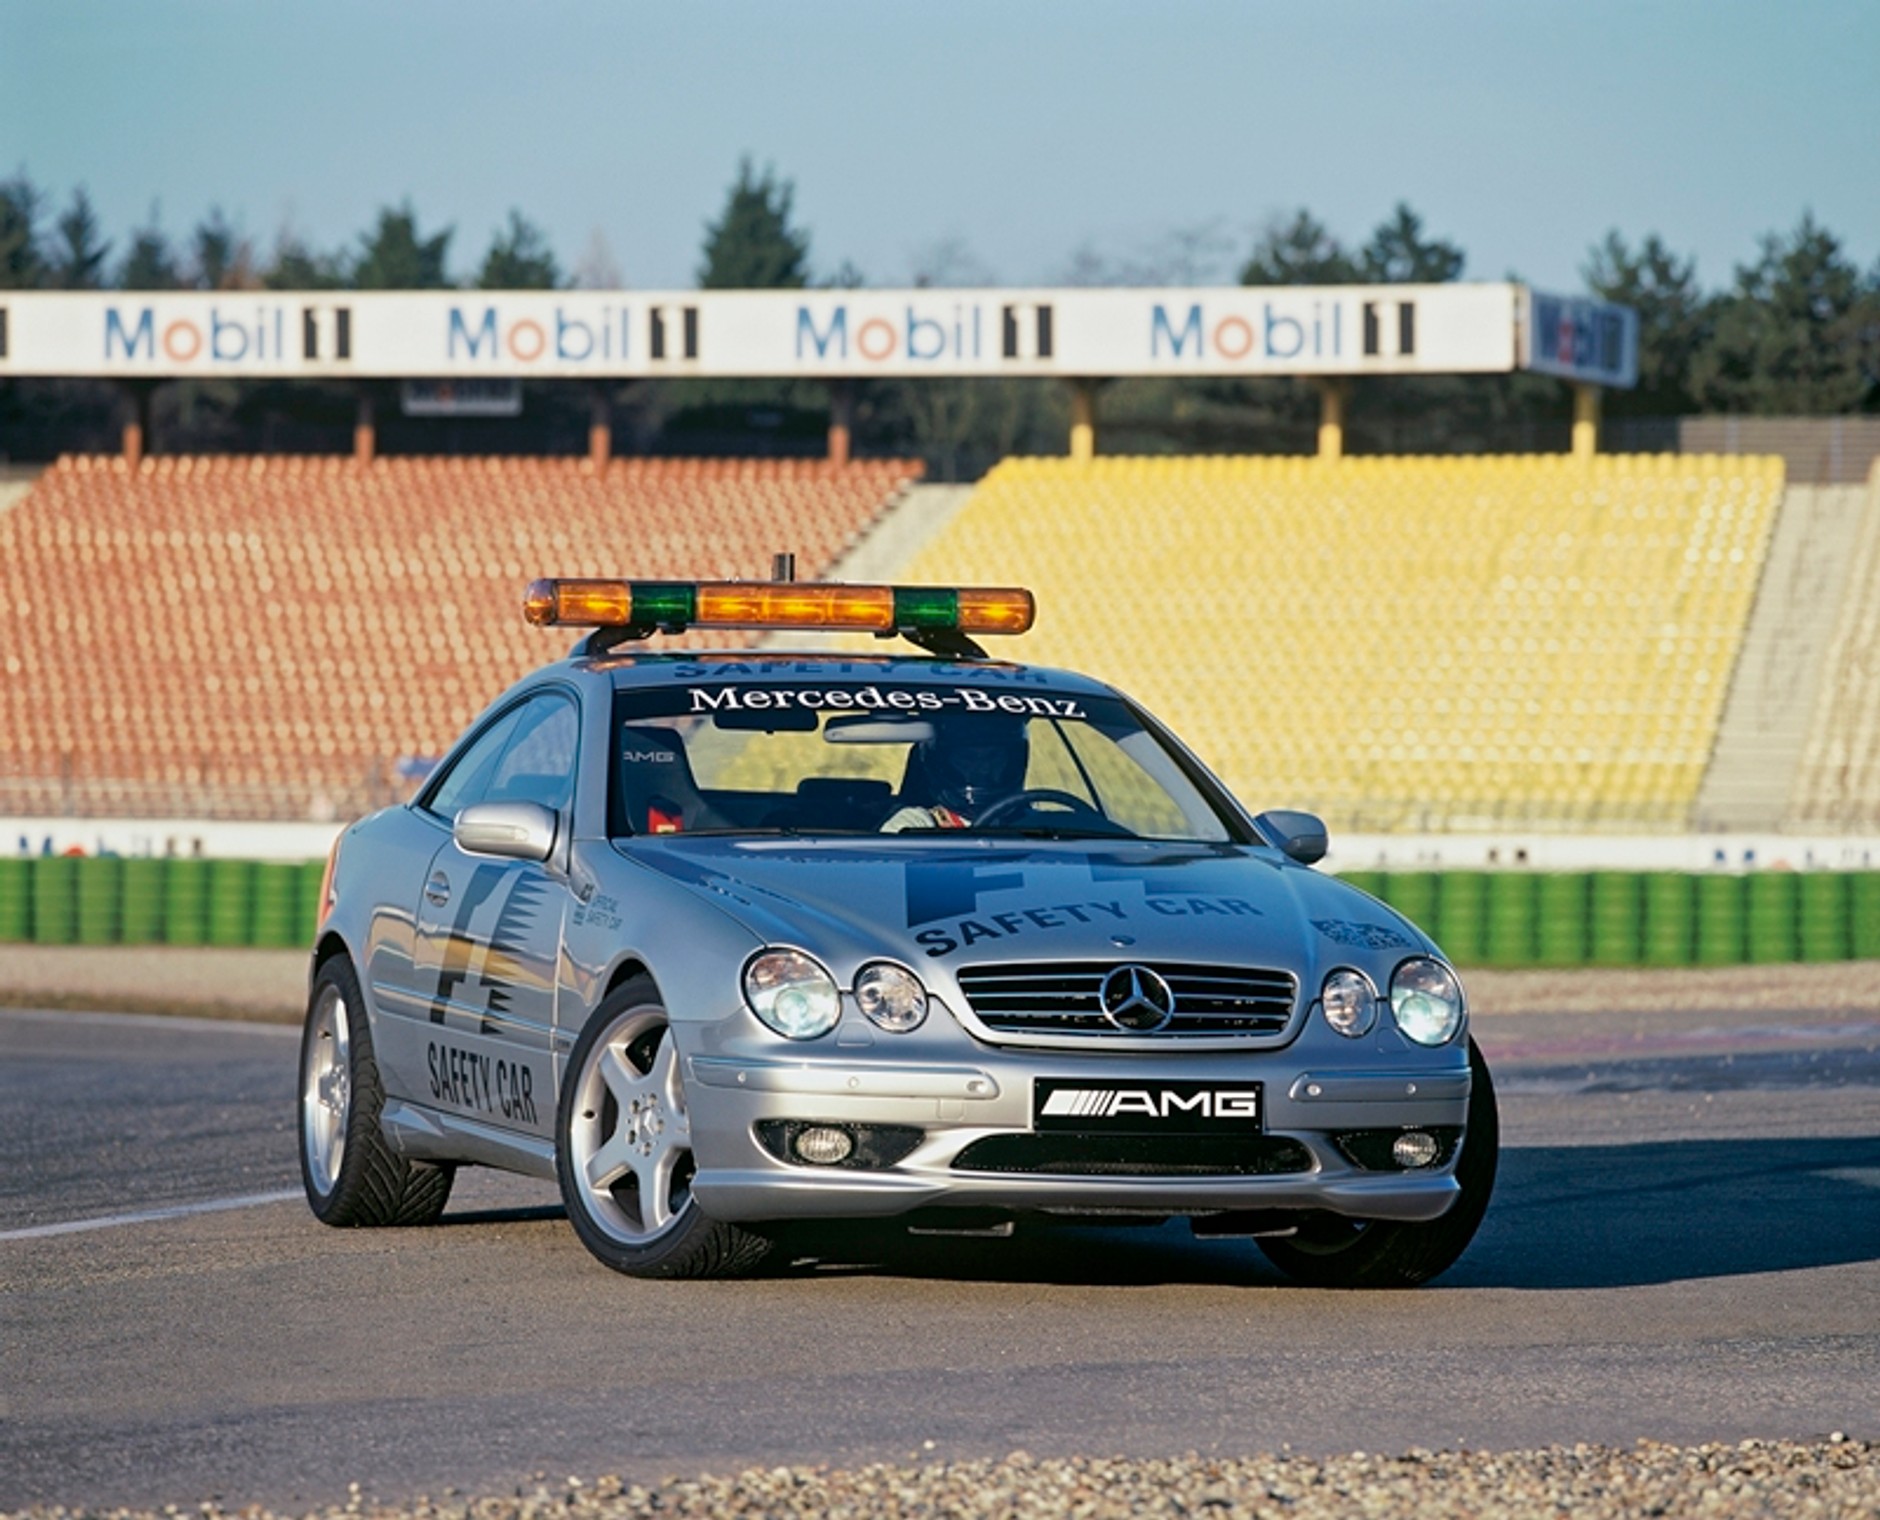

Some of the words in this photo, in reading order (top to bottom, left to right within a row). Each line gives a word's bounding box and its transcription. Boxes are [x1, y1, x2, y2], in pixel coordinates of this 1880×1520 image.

[104, 307, 283, 363] Mobil
[448, 306, 630, 362] Mobil
[797, 305, 982, 362] Mobil
[1151, 302, 1342, 361] Mobil
[688, 686, 1087, 718] Mercedes-Benz
[915, 901, 1128, 957] SAFETY
[1145, 898, 1264, 917] CAR
[427, 1041, 493, 1113] SAFETY
[497, 1059, 538, 1125] CAR
[1105, 1090, 1256, 1118] AMG
